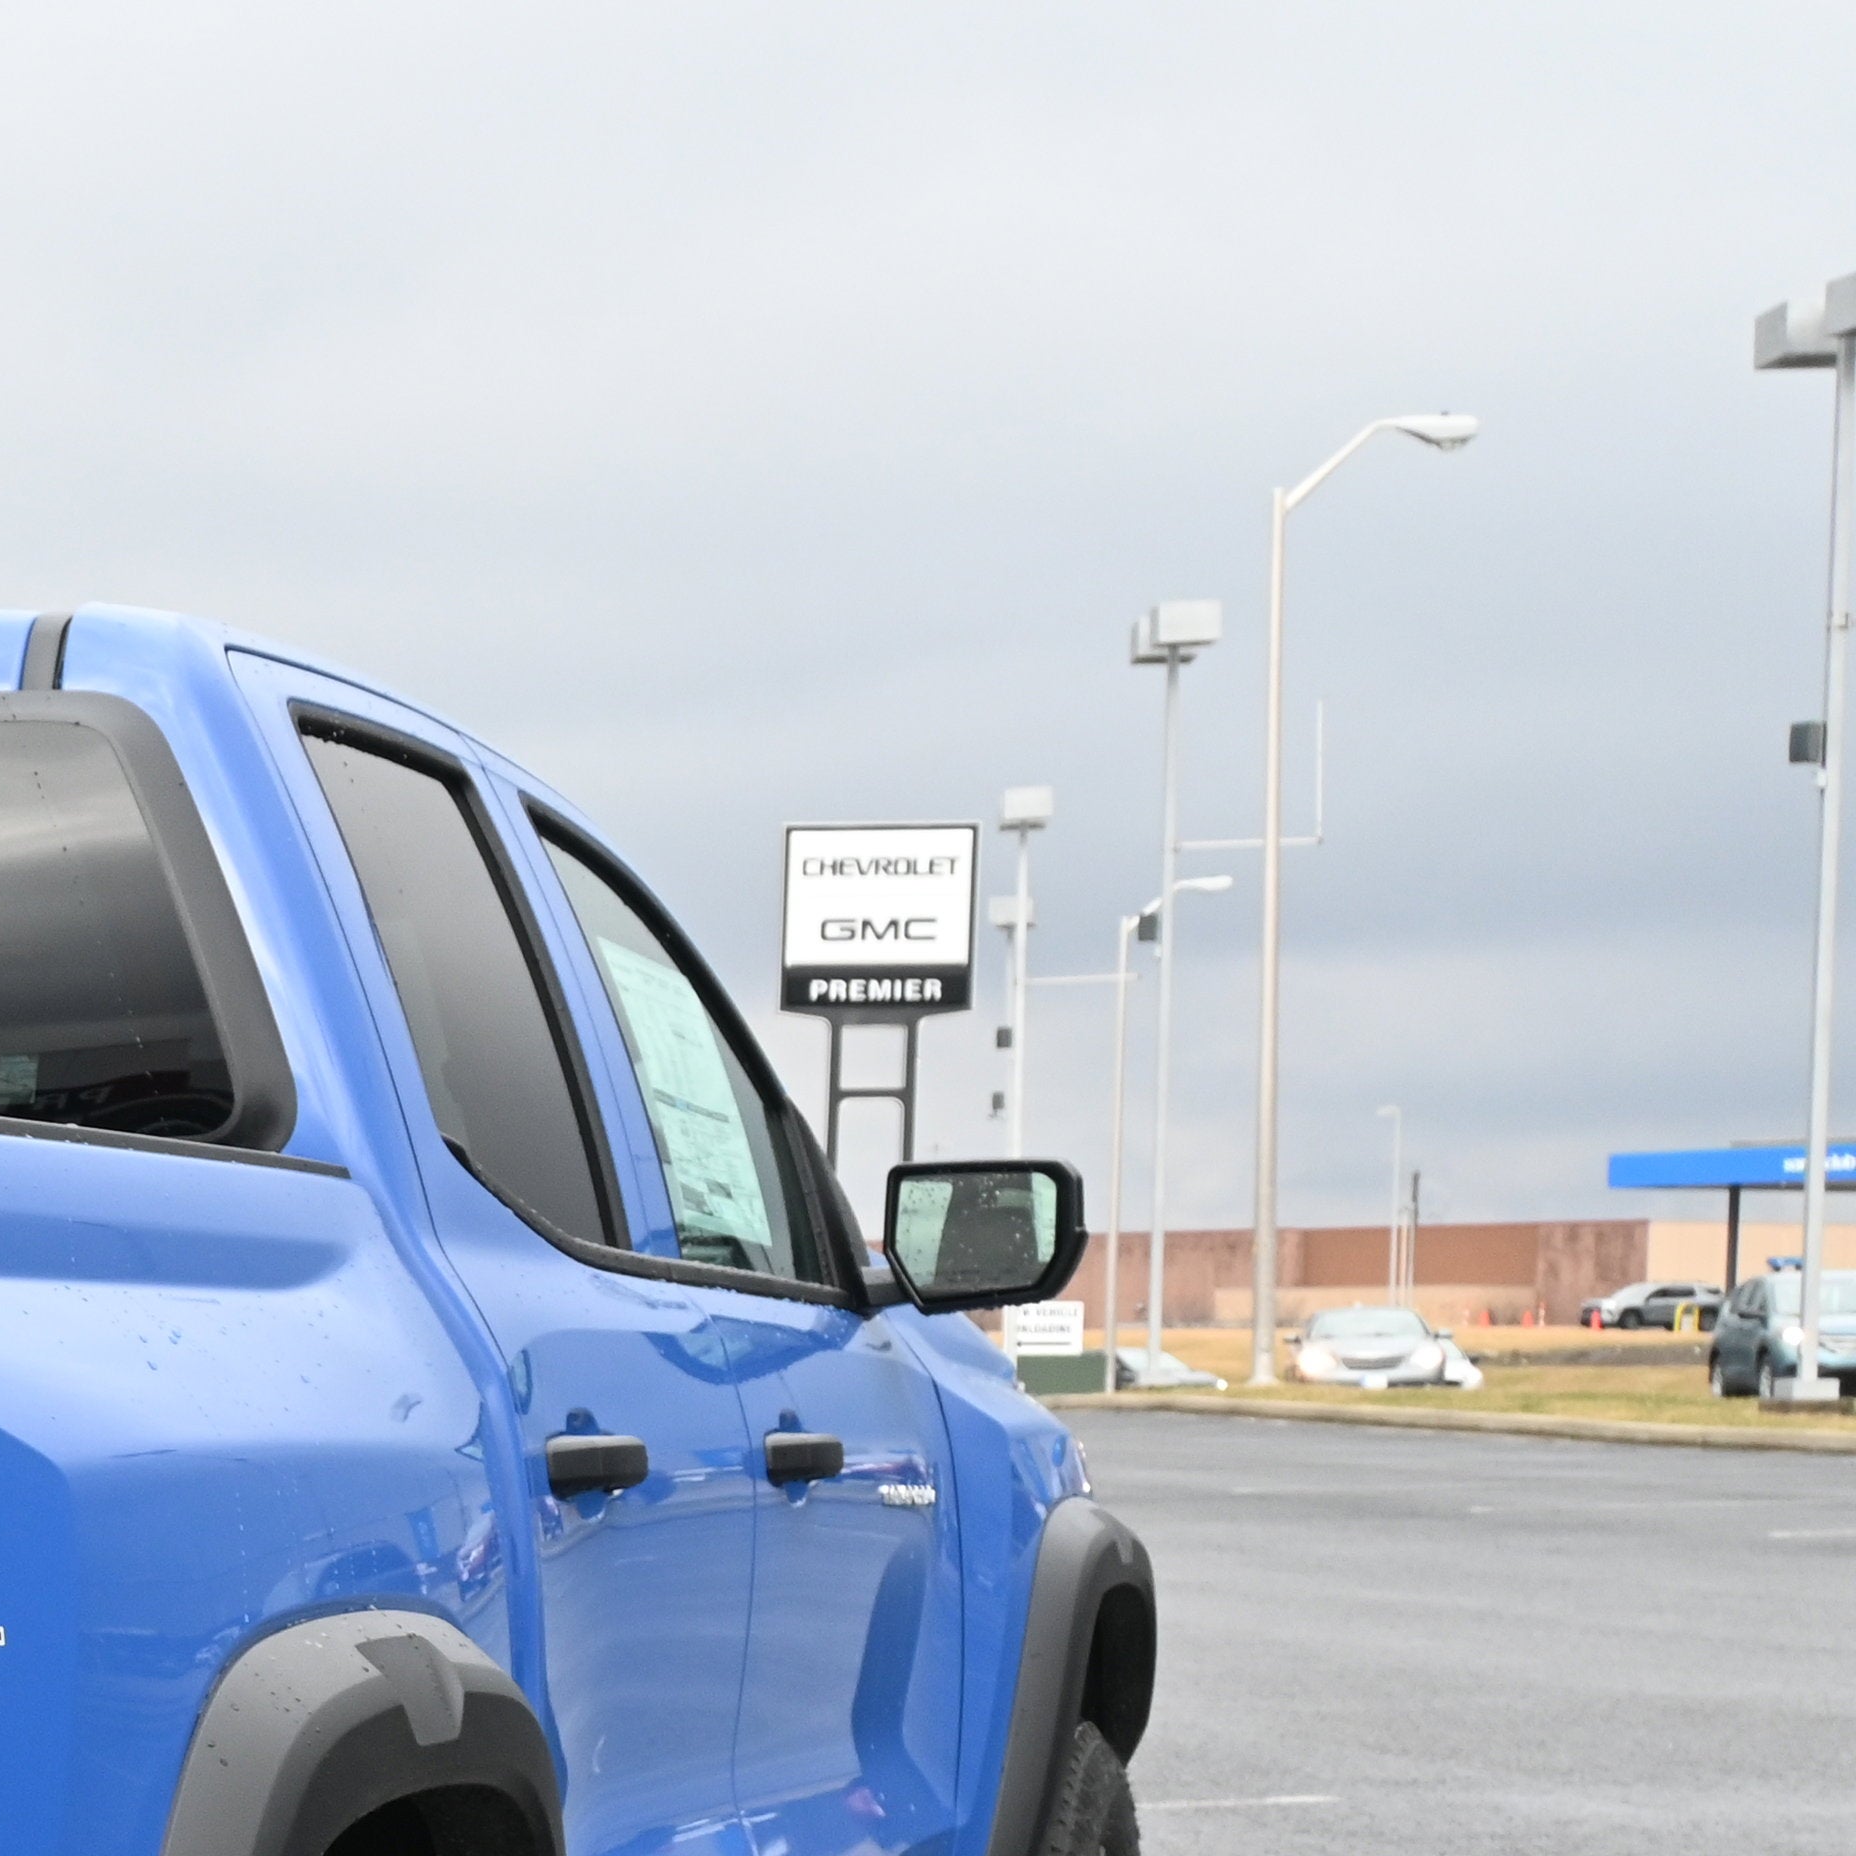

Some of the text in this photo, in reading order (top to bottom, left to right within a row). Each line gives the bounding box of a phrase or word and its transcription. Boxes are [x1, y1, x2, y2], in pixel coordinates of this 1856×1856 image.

[802, 856, 959, 876] CHEVROLET
[820, 918, 938, 941] GMC
[809, 978, 943, 1002] PREMIER
